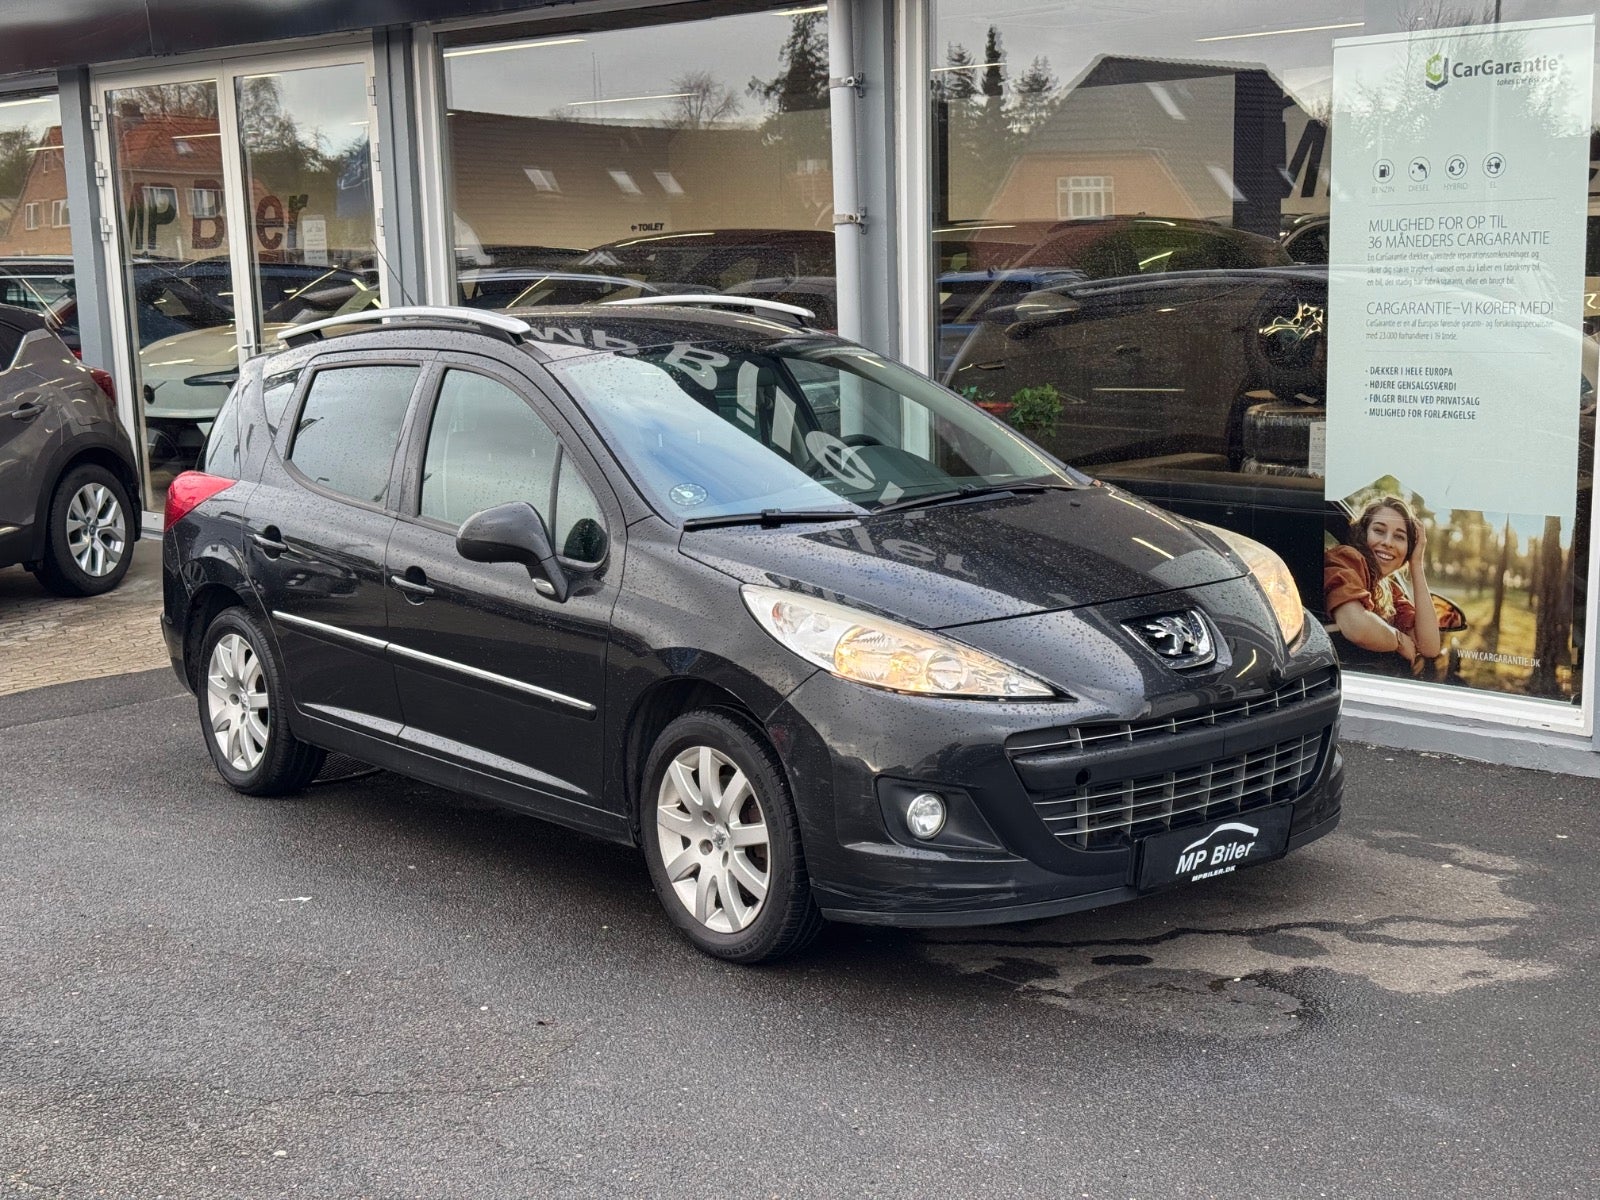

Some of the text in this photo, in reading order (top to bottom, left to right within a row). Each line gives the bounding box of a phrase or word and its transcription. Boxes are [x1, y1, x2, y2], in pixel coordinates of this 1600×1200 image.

[1453, 55, 1559, 78] CarGarantie
[1408, 184, 1429, 192] DIESEL
[1444, 182, 1468, 191] HYBRID
[638, 222, 664, 231] TOILET
[1368, 215, 1507, 232] MULIGHED FOR OP TIL
[1368, 231, 1550, 249] 36 MÅNEDERS CARGARANTIE
[1475, 301, 1517, 315] KØRER
[1520, 301, 1554, 315] MED!
[1370, 366, 1399, 376] DÆKKER
[1405, 367, 1423, 376] HELE
[1425, 368, 1453, 377] EUROPA
[1369, 380, 1457, 391] HØJERE GENSALGSVÆRDI
[1369, 394, 1480, 406] FØLGER BILEN VED PRIVATSALG
[1369, 408, 1476, 420] MULIGHED FOR FORLÆNGELSE
[1457, 649, 1540, 667] WWW.CARGARANTIE.DK
[1175, 841, 1255, 875] MP Biler
[1191, 865, 1236, 882] MPBILER.DK
